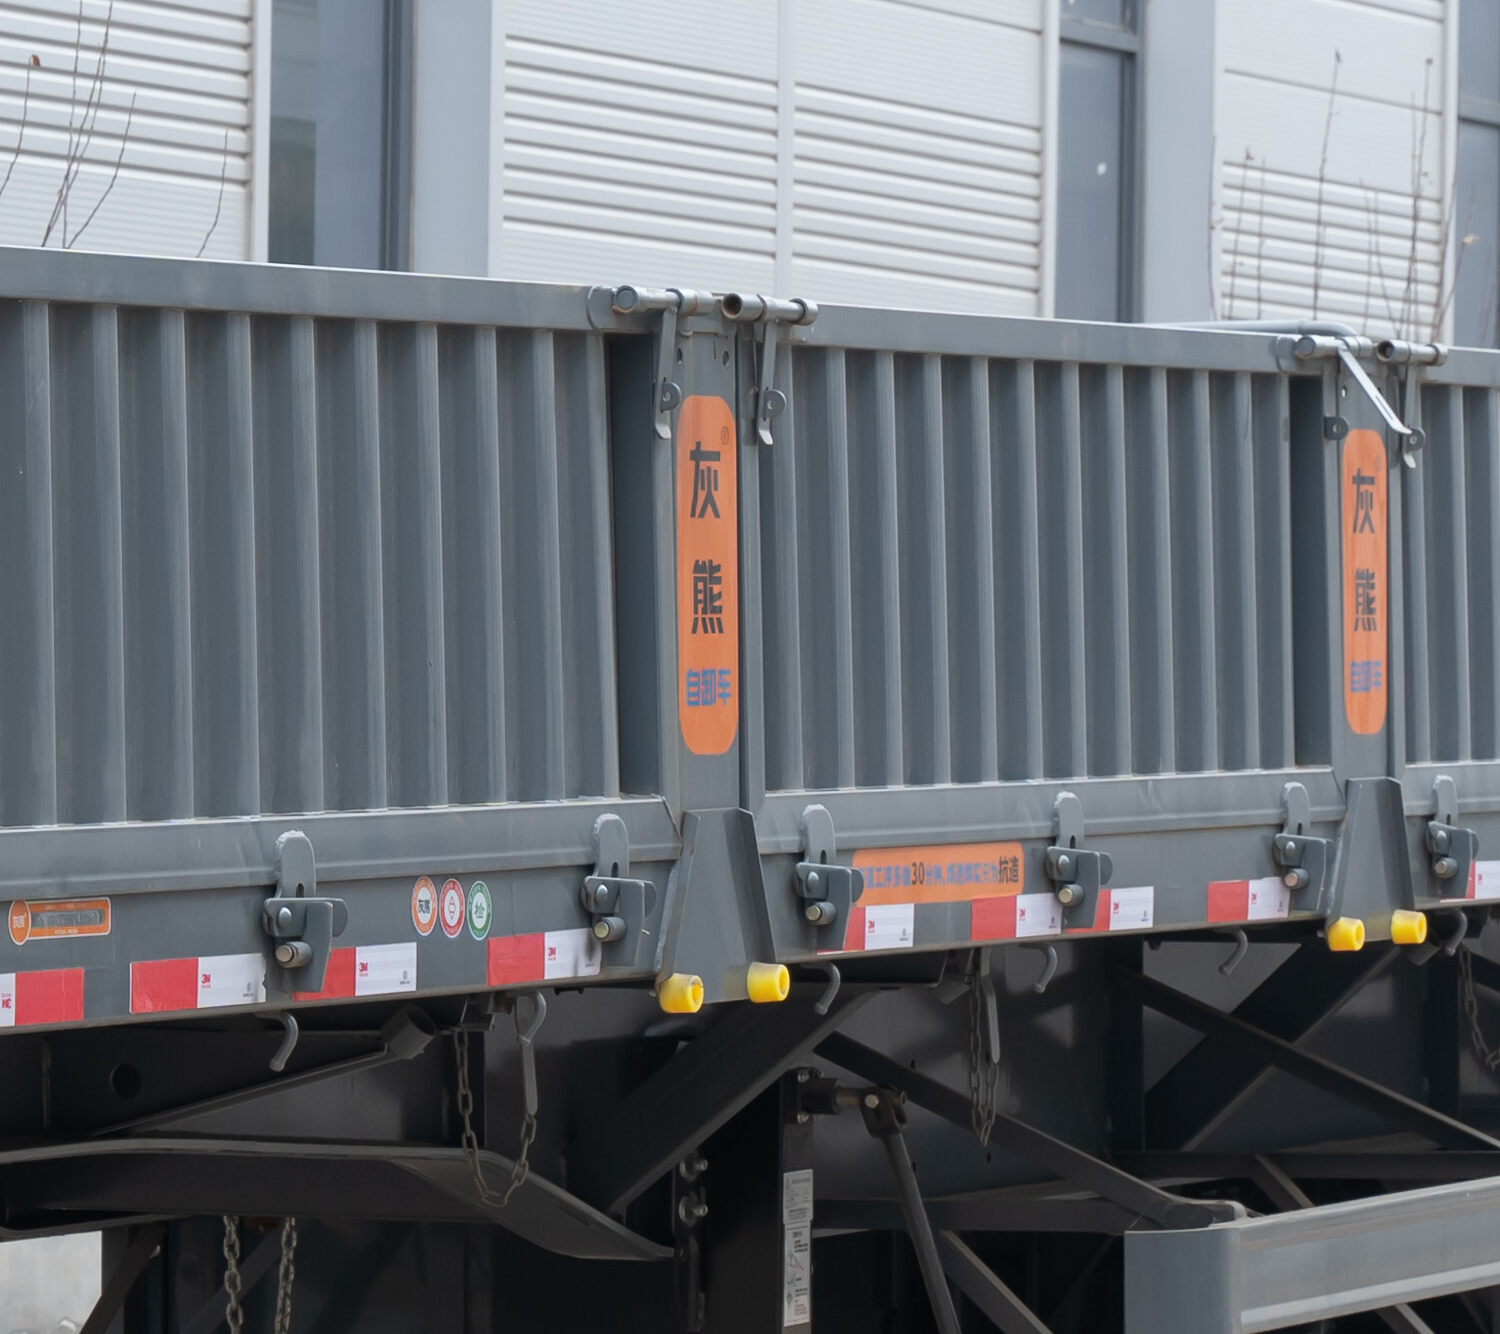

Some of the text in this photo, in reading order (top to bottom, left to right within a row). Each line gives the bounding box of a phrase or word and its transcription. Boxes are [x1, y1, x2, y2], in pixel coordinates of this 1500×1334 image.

[690, 441, 724, 635] 灰熊
[1352, 468, 1378, 632] 灰熊
[686, 668, 732, 707] 自卸车
